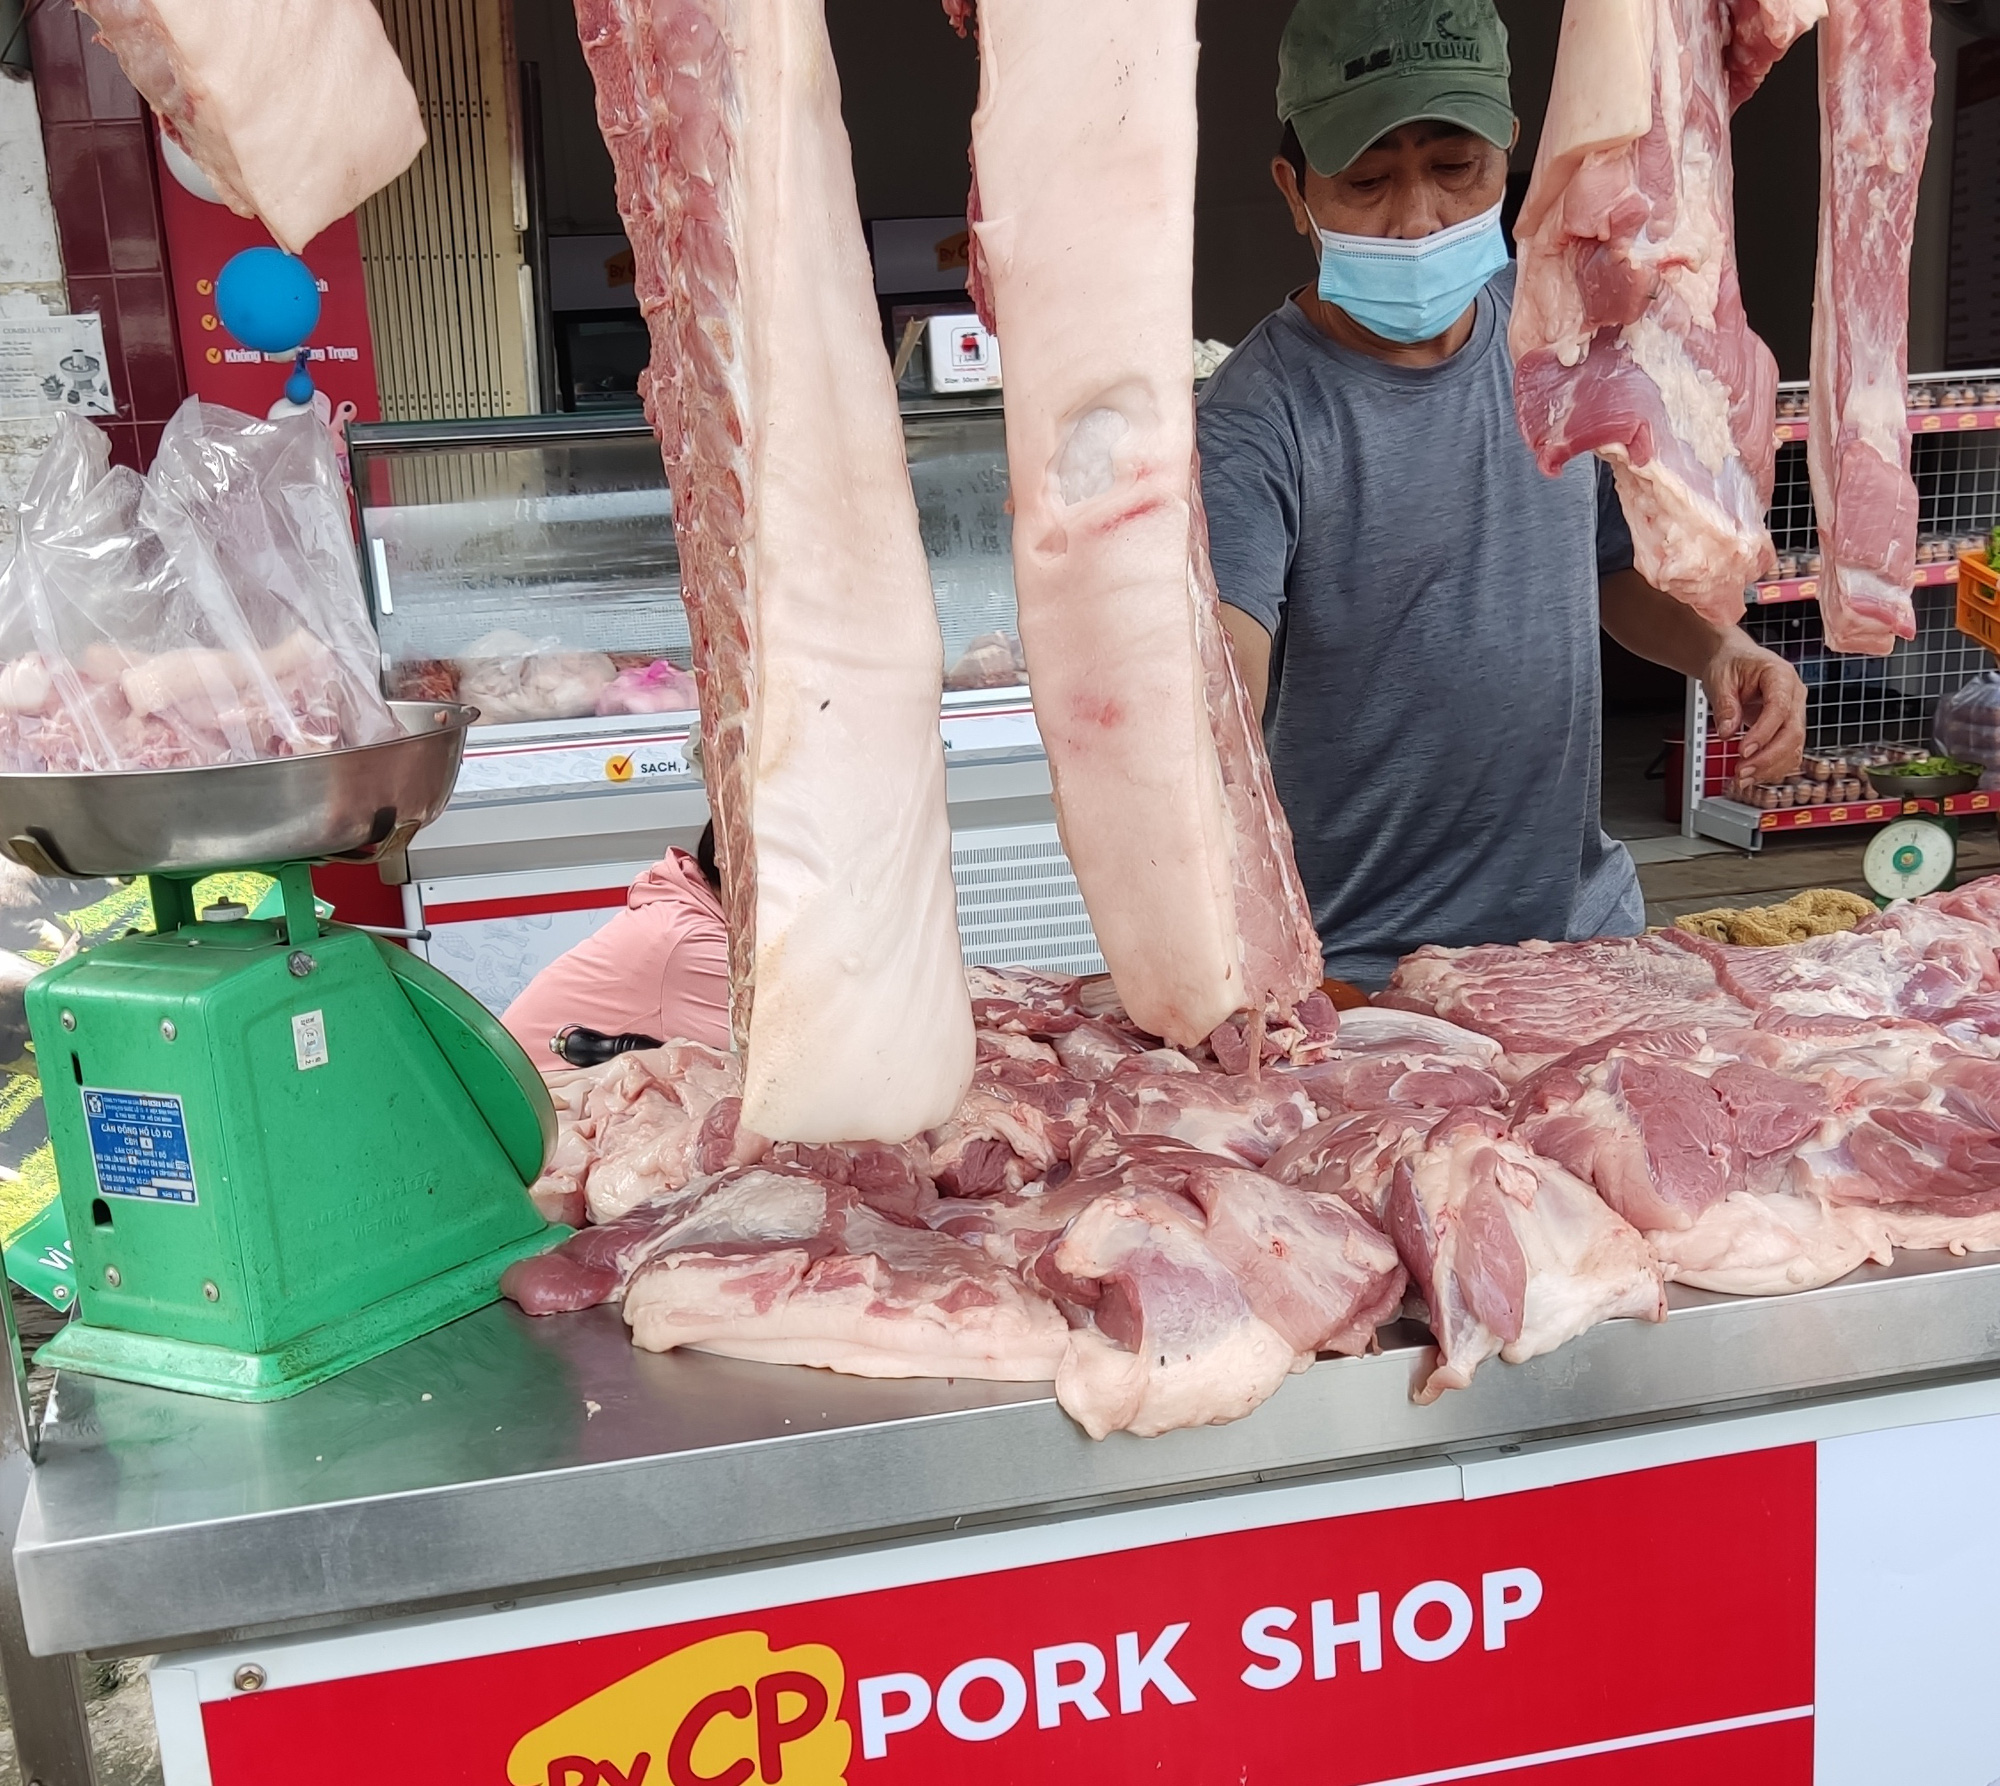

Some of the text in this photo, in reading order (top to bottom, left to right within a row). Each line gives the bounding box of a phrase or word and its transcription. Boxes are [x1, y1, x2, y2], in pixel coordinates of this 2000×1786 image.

[667, 1671, 828, 1786] CP
[858, 1567, 1542, 1760] PORK SHOP
